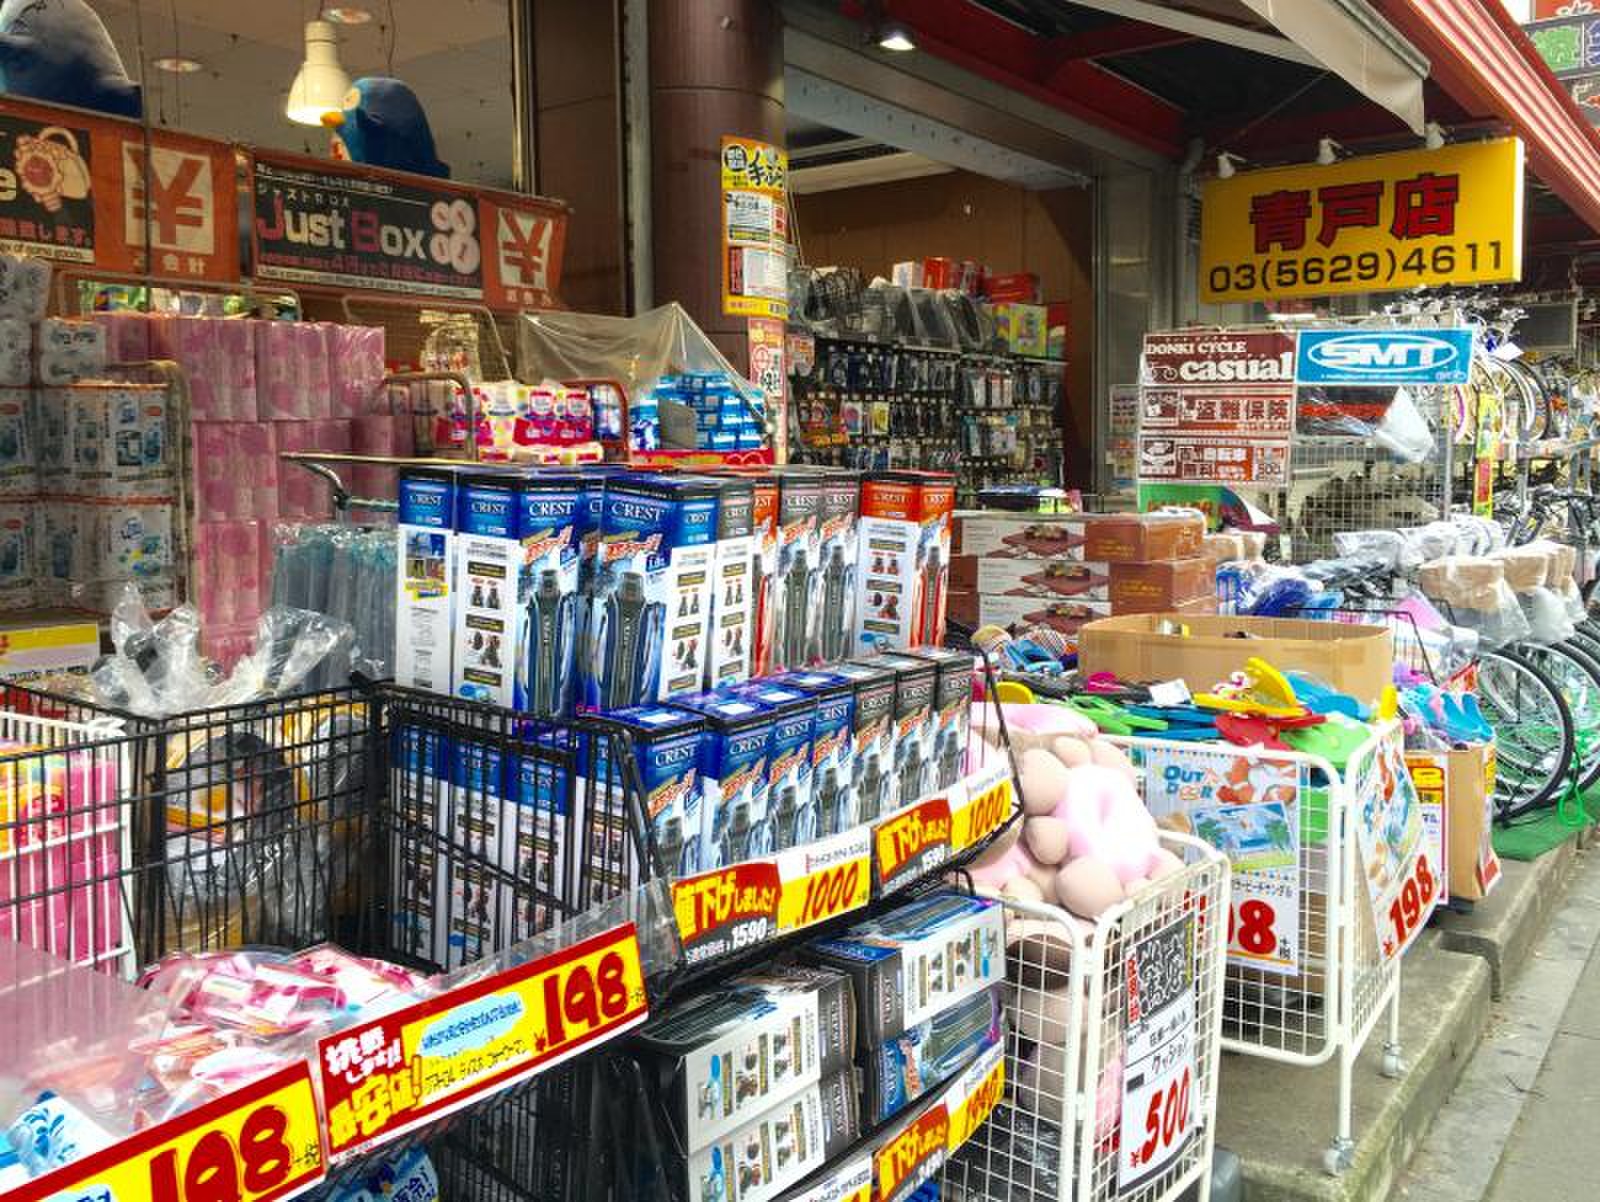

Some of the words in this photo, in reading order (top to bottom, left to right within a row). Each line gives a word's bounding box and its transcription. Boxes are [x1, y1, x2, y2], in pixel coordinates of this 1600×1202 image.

[256, 191, 346, 250] Just
[351, 208, 427, 260] Box
[1249, 172, 1460, 254] 青戸店
[1209, 241, 1501, 293] 03(5629)4611
[1146, 342, 1195, 355] DONKI
[1198, 340, 1246, 354] CYCLE
[1319, 342, 1439, 366] SMT
[1180, 351, 1294, 382] casual
[528, 500, 575, 517] CREST
[611, 502, 665, 522] CREST
[775, 718, 813, 741] CREST
[654, 743, 697, 767] CREST
[728, 733, 769, 756] CREST
[802, 861, 860, 924] 1000
[731, 916, 768, 950] 1590
[149, 1104, 292, 1202] 198
